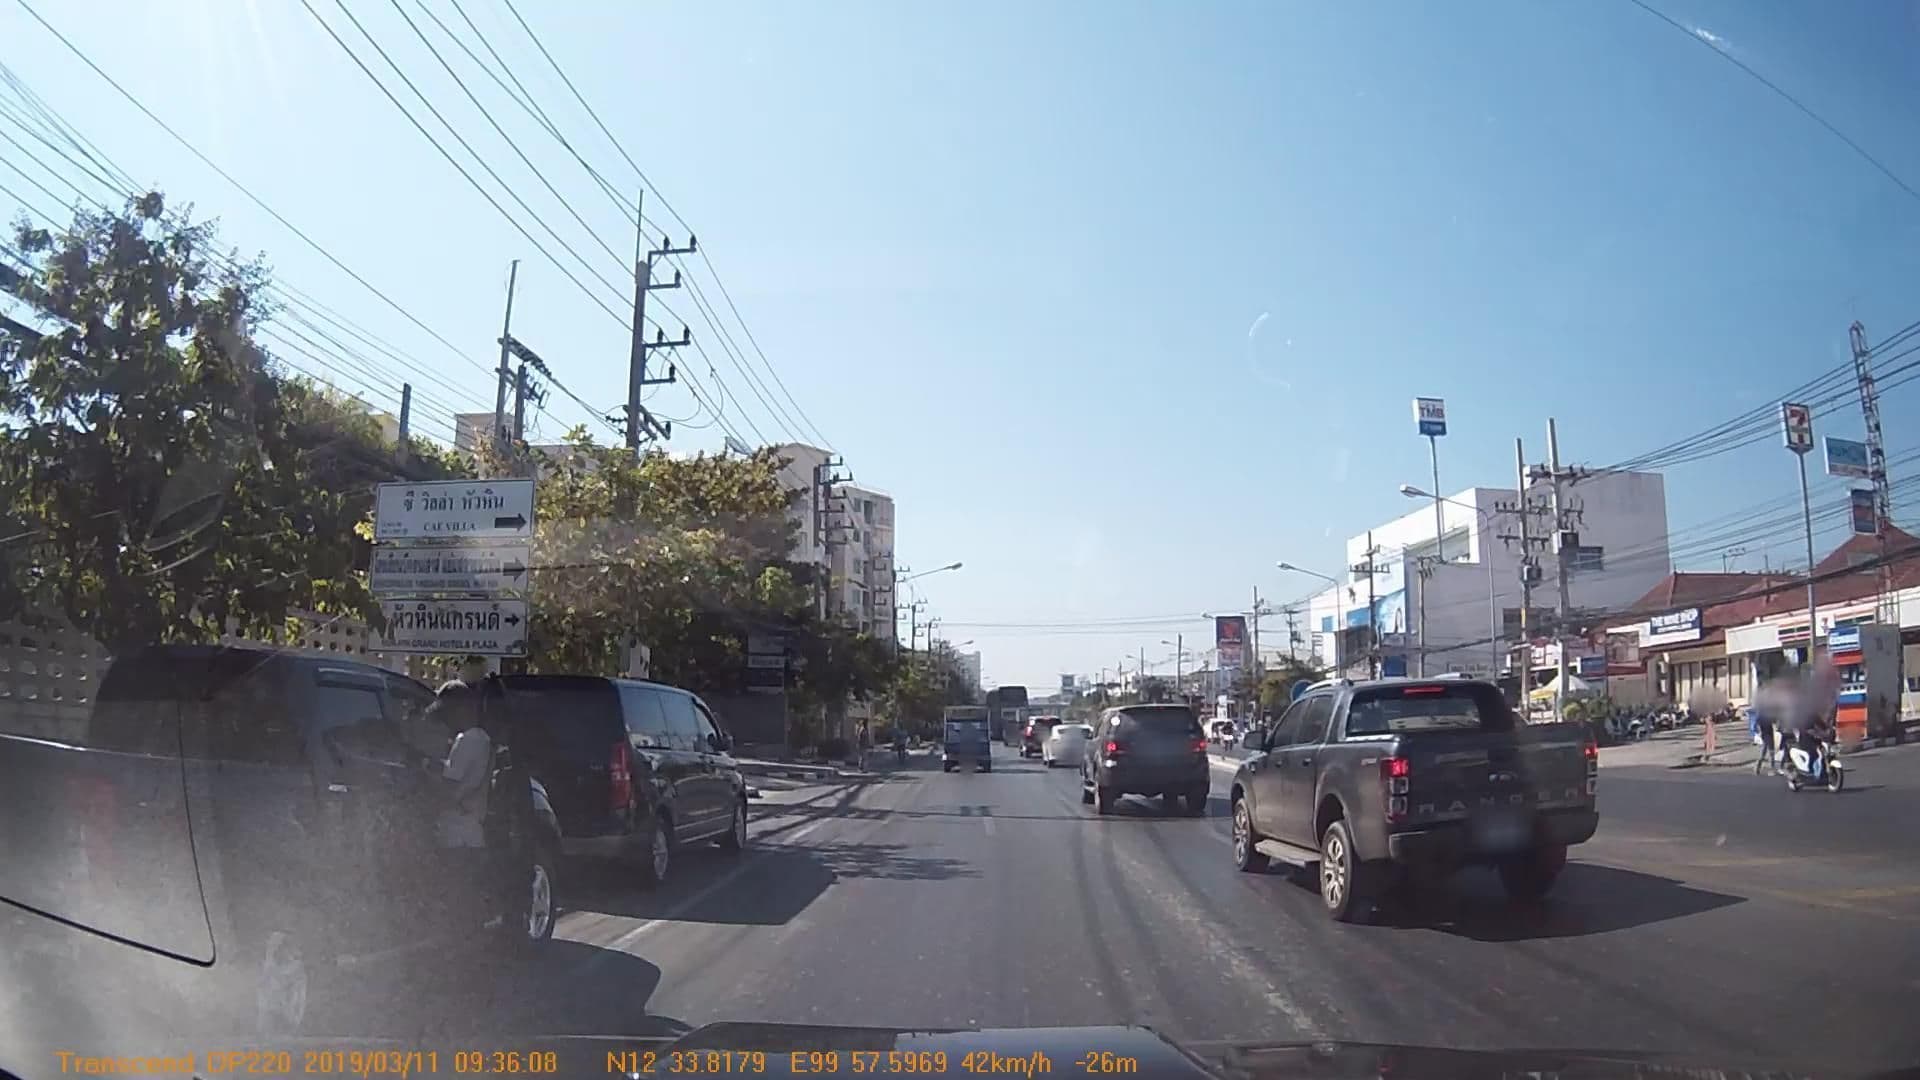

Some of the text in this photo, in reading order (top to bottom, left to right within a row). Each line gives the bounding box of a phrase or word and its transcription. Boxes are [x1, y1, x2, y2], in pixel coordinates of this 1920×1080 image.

[393, 603, 500, 631] หัวหินแกรนด์
[472, 640, 498, 649] PLAZA
